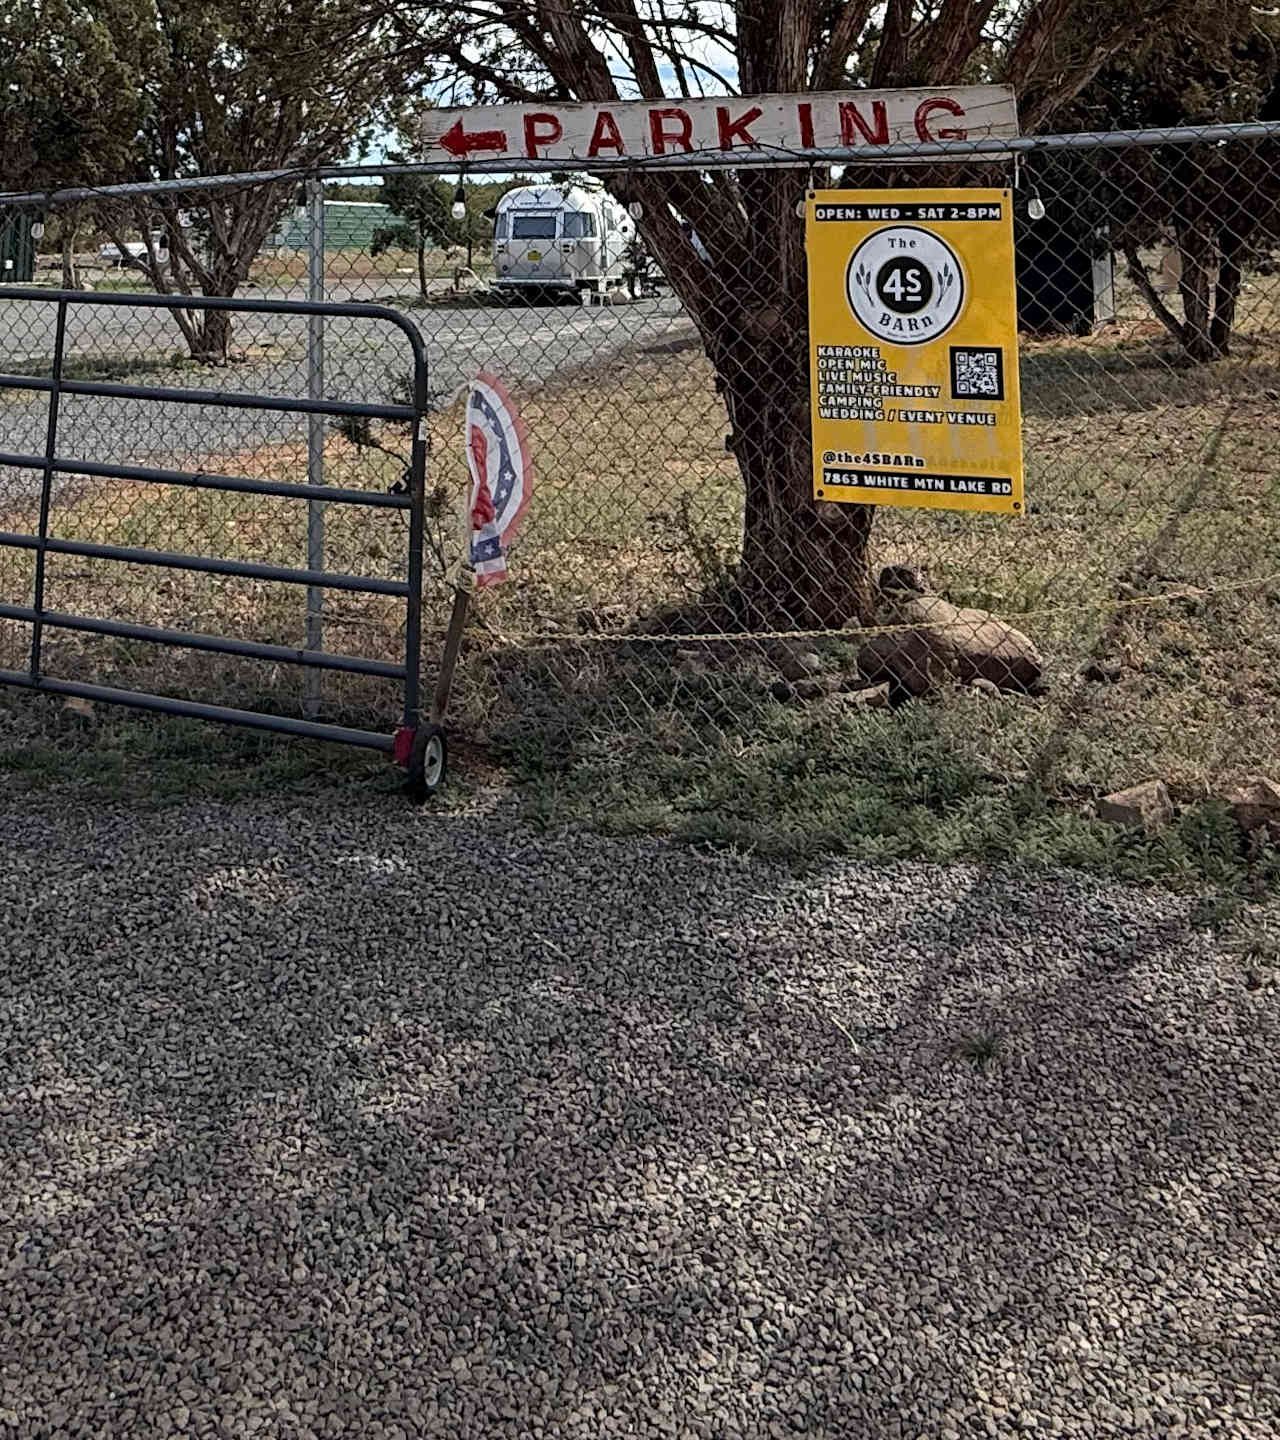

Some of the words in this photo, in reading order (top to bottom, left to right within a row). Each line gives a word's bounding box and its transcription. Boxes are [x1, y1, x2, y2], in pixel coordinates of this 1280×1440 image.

[523, 97, 967, 158] PARKING
[816, 208, 861, 220] OPEN:
[867, 208, 900, 219] WED
[918, 208, 945, 219] SAT
[950, 207, 1001, 219] 2-8PM
[888, 238, 917, 249] The
[883, 269, 922, 301] 4S
[878, 312, 934, 331] BARn
[818, 347, 880, 358] KARAOKE
[818, 359, 855, 369] OPEN
[861, 360, 886, 370] MIC
[819, 372, 848, 382] LIVE
[853, 372, 896, 383] MUSIC
[819, 384, 940, 397] FAMILY-FRIENDLY
[819, 396, 882, 408] CAMPING
[820, 408, 884, 420] WEDDING
[899, 411, 943, 423] EVENT
[948, 412, 996, 425] VENUE
[824, 472, 859, 485] 7863
[864, 475, 909, 488] WHITE
[914, 479, 945, 491] MTN
[950, 481, 986, 493] LAKE
[991, 483, 1012, 495] RD
